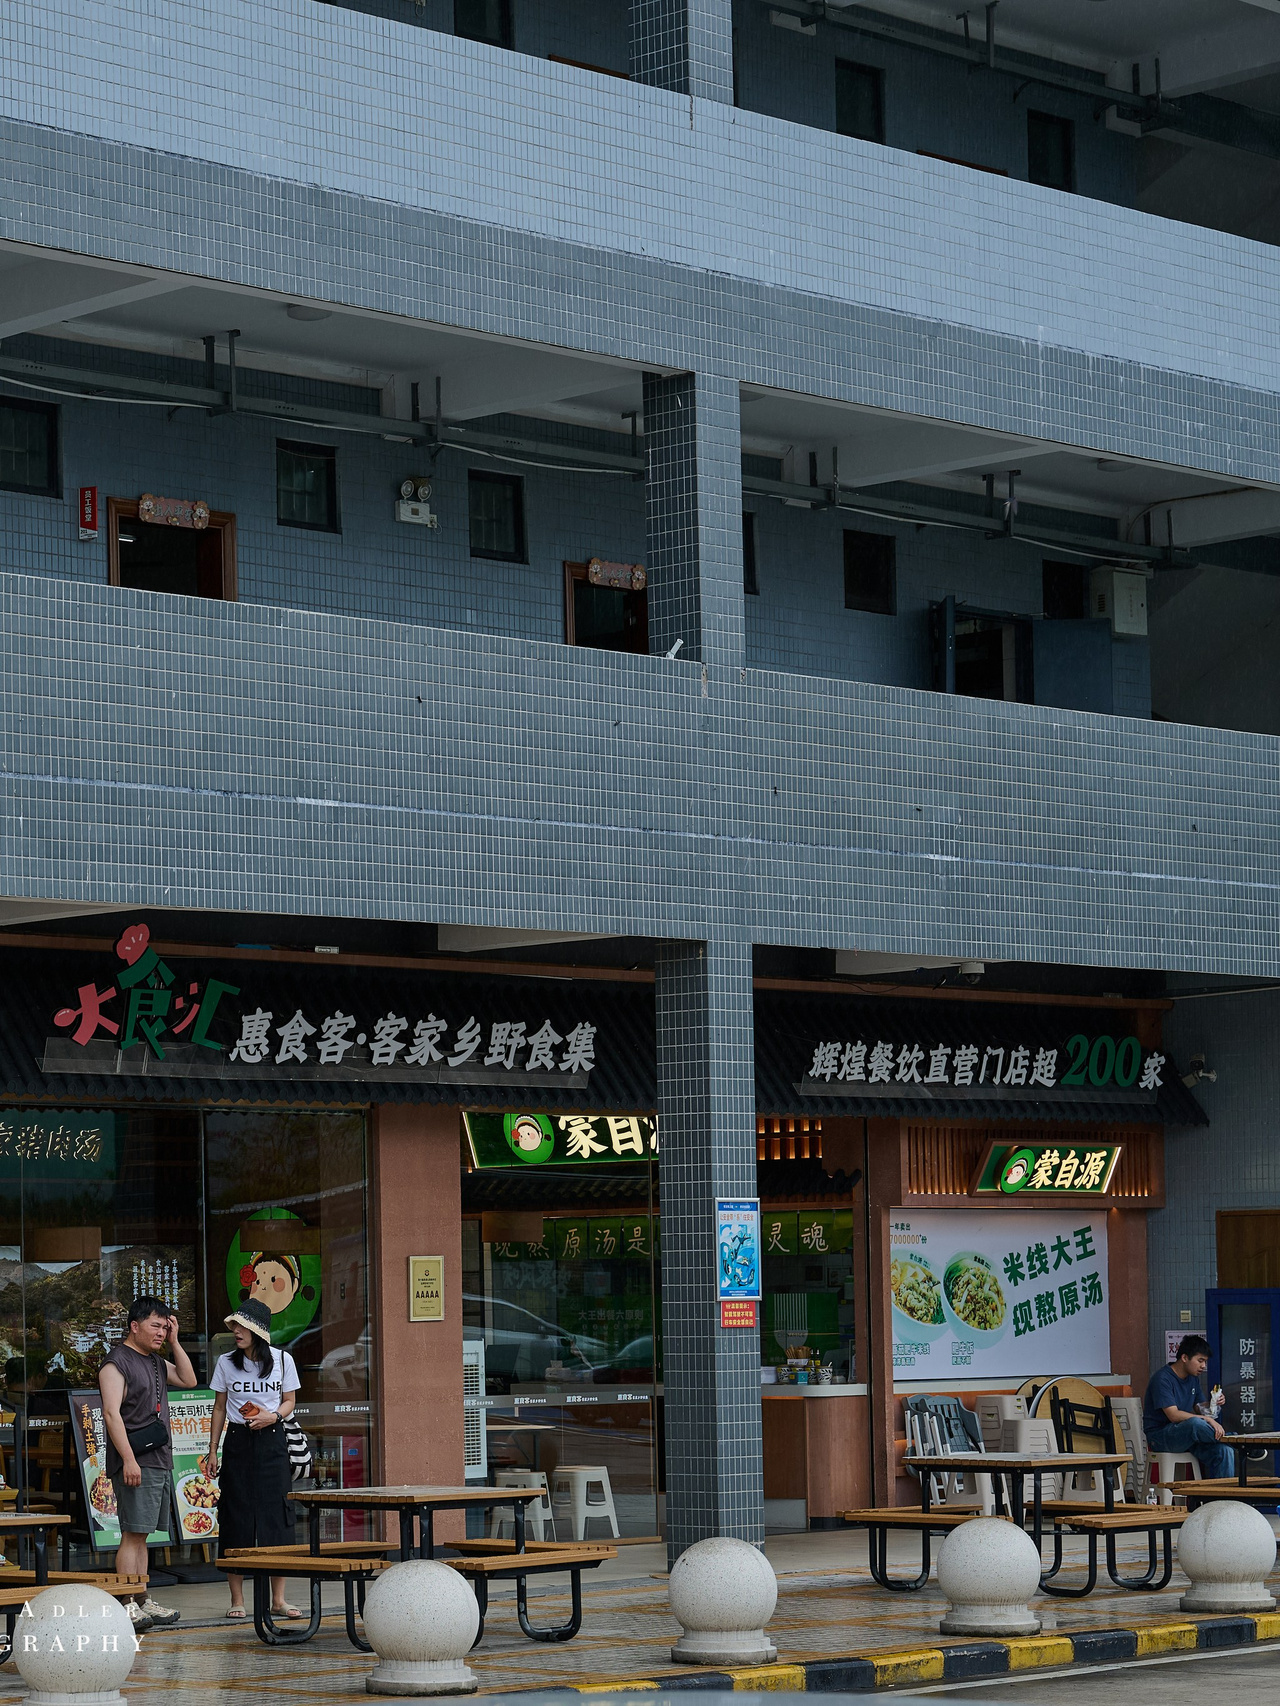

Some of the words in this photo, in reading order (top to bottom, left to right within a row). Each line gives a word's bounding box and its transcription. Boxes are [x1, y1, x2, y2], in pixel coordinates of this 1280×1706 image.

[84, 490, 93, 522] 员工饭堂
[808, 1034, 1166, 1090] 辉煌餐饮直营门店超200家
[558, 1114, 658, 1159] 蒙自
[1027, 1149, 1107, 1189] 蒙自源
[768, 1222, 829, 1252] 灵魂
[1003, 1225, 1097, 1287] 米线大王
[1012, 1271, 1104, 1338] 现熬原汤
[1239, 1338, 1256, 1428] 防暴器材
[170, 1417, 227, 1435] 特价套
